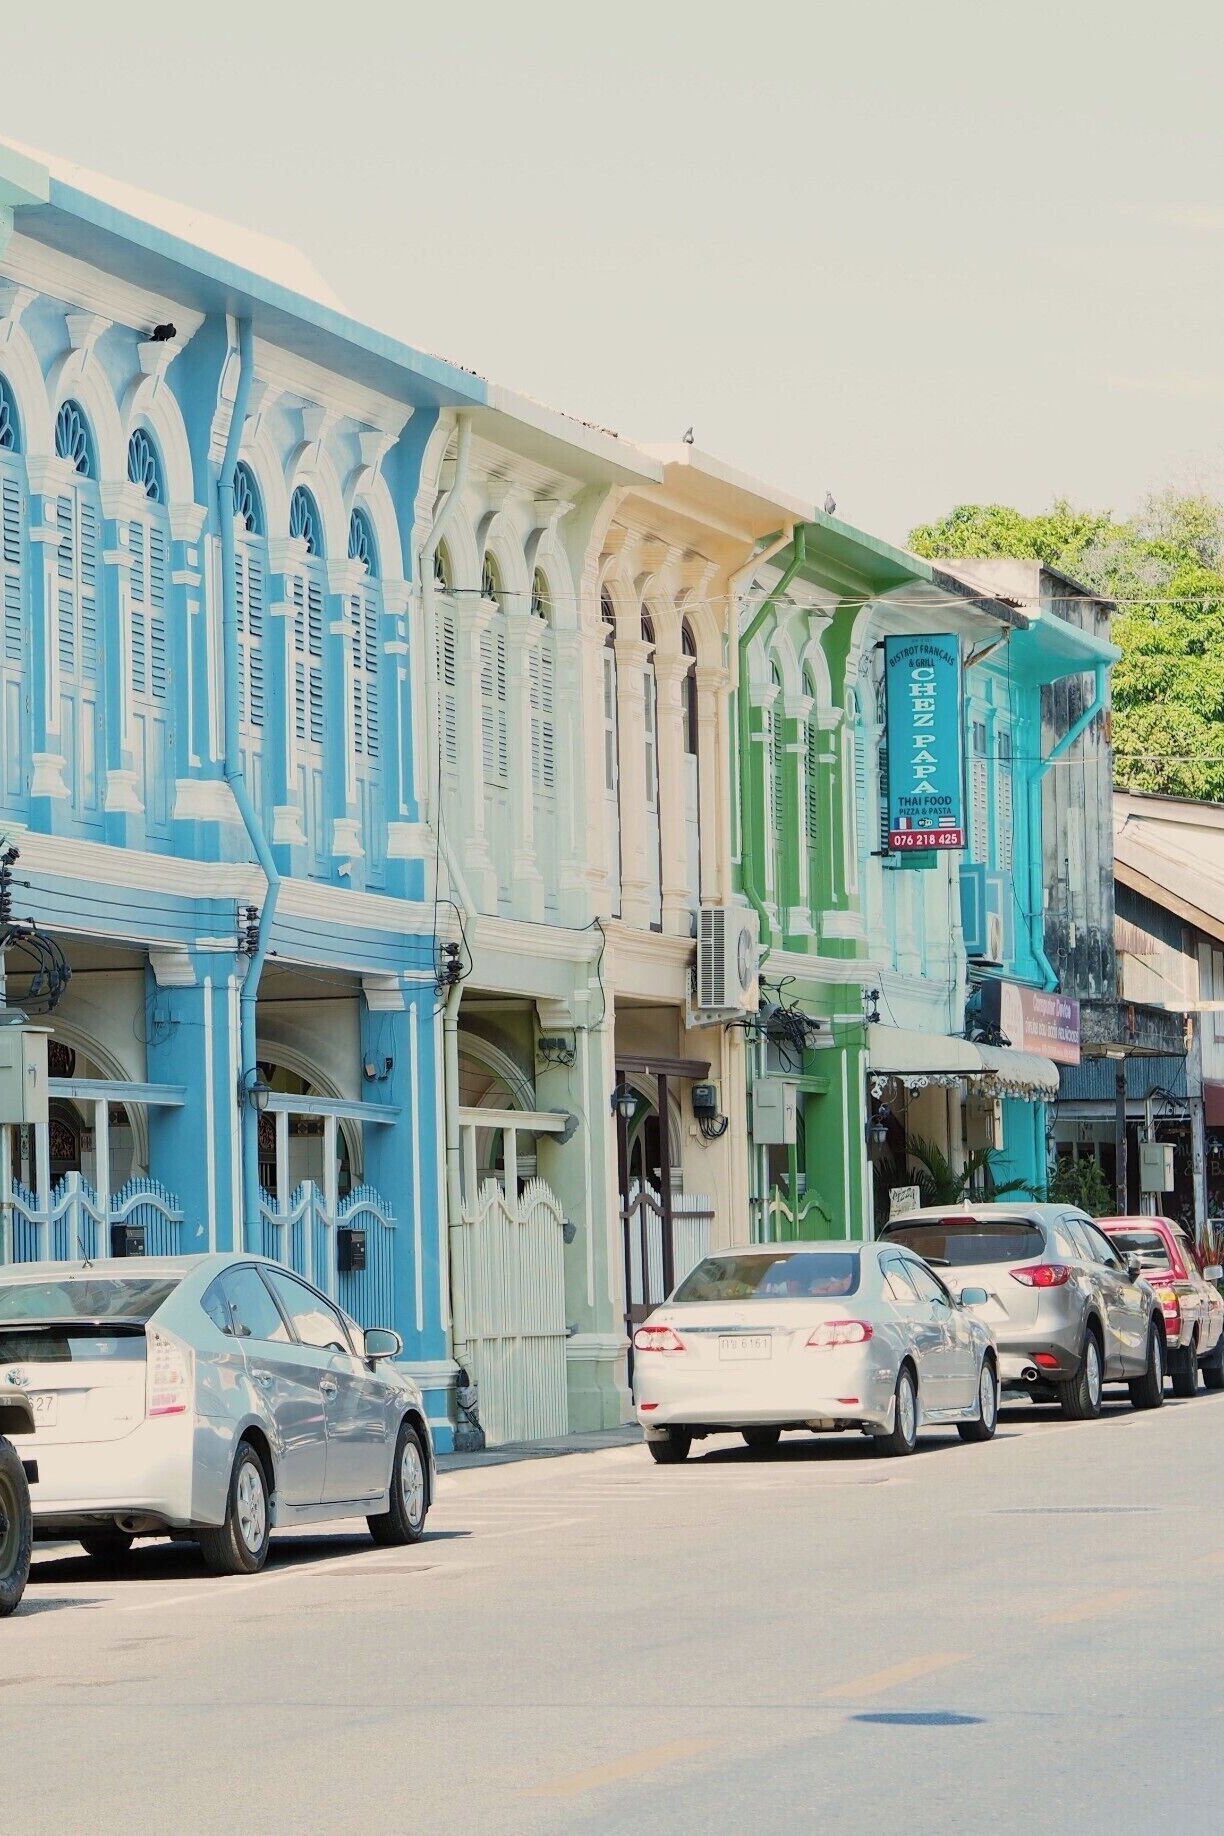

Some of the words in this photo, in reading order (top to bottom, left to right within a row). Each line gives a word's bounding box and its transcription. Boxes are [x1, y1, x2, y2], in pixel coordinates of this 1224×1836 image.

[889, 646, 918, 667] BISTROT
[919, 644, 955, 666] FRANÇAIS
[908, 659, 914, 668] &
[915, 659, 936, 668] GRILL
[908, 667, 937, 727] CHEZ
[910, 734, 939, 794] PAPA
[898, 796, 923, 806] THAI
[924, 796, 952, 806] FOOD
[899, 807, 920, 816] PIZZA
[921, 807, 927, 815] &
[928, 807, 952, 815] PASTA
[894, 835, 914, 846] 076
[916, 834, 936, 845] 218
[938, 833, 958, 845] 425
